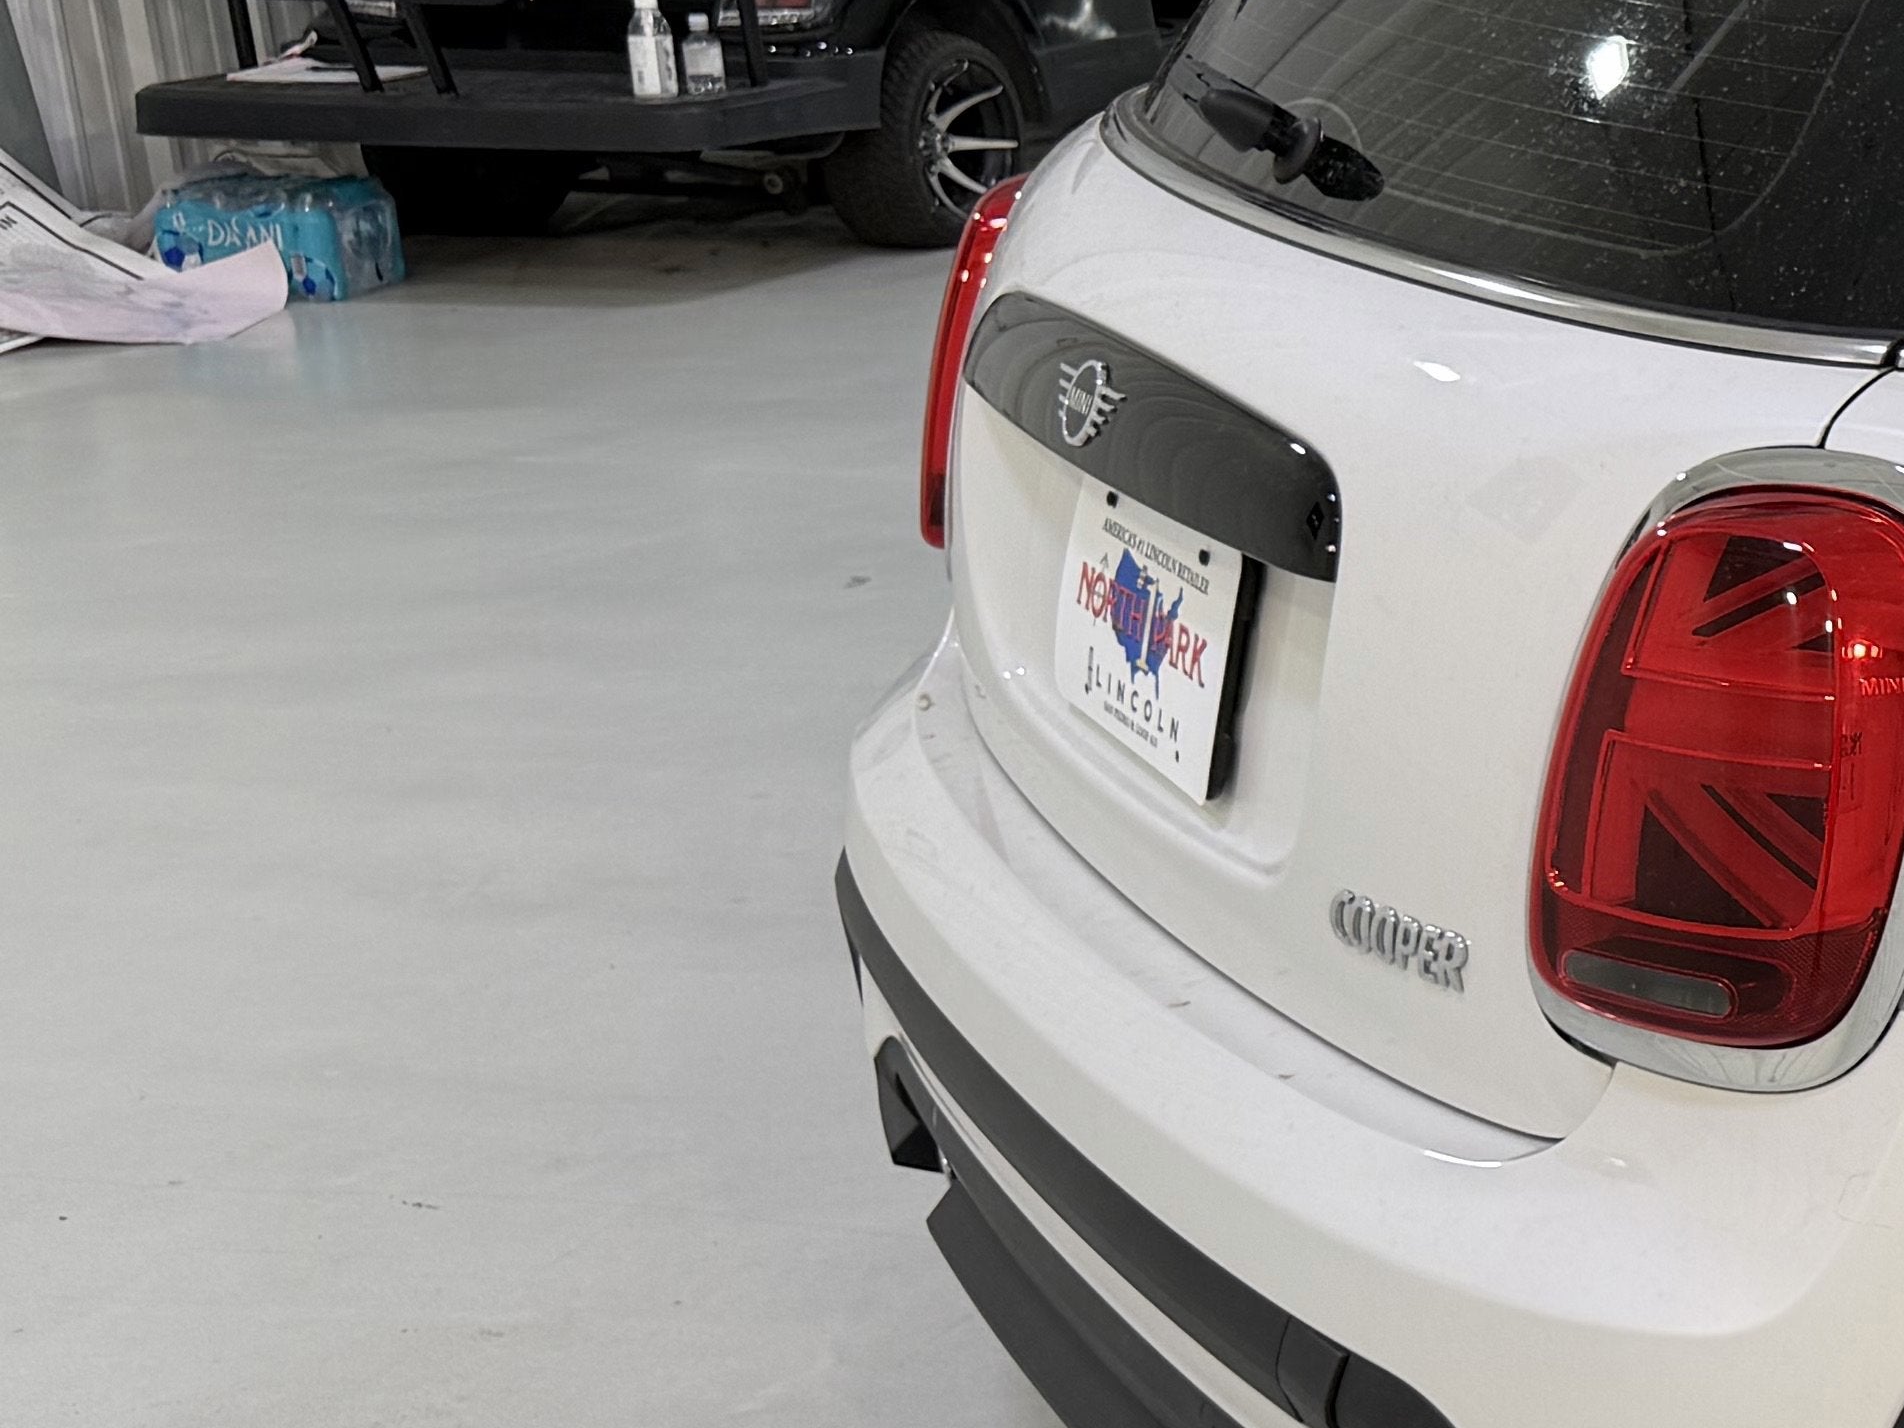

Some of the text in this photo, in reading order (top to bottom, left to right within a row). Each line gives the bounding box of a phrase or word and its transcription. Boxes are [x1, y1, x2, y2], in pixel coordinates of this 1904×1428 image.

[1144, 541, 1179, 575] LINCOLN
[1177, 561, 1210, 596] RETAILER
[1076, 561, 1208, 689] NORTH PARK
[1096, 663, 1180, 743] LINCOLN
[1328, 888, 1470, 994] COOPER
